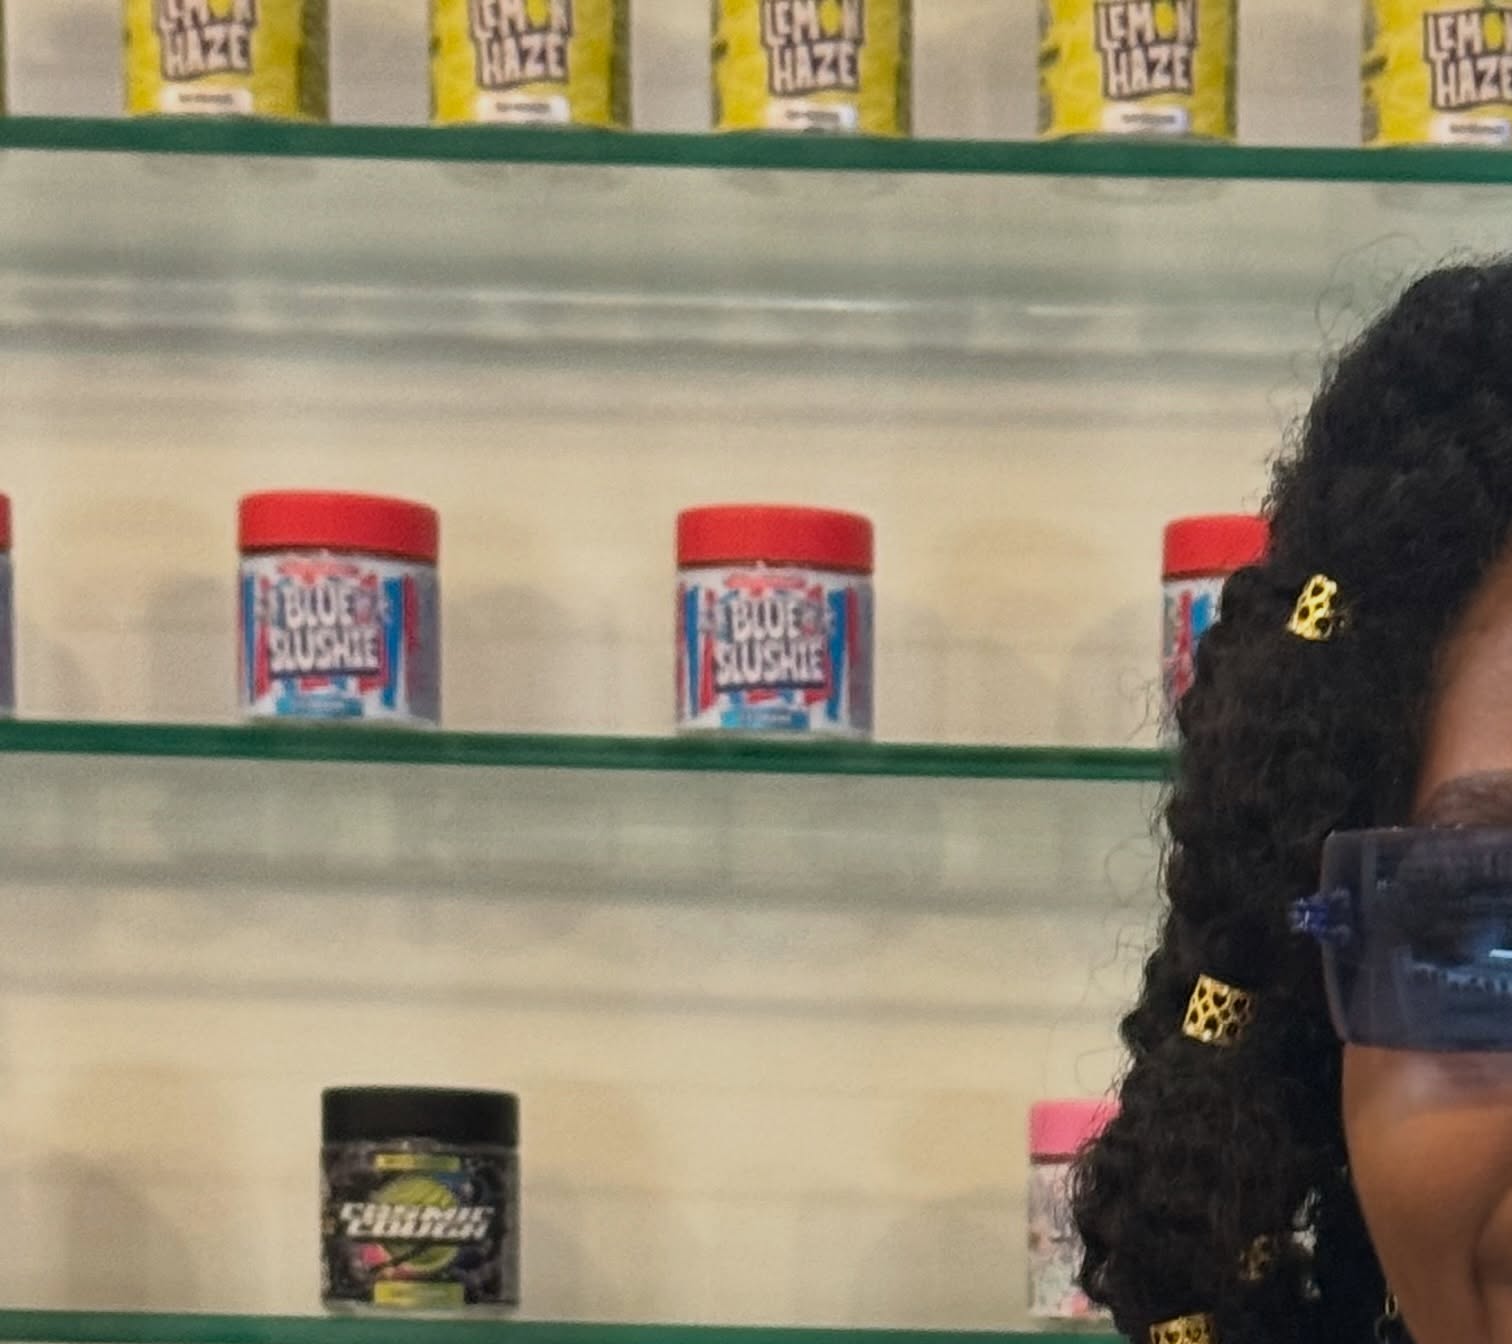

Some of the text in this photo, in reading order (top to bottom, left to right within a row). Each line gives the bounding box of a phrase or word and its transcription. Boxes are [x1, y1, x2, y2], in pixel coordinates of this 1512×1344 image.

[762, 0, 862, 46] LEMON
[1097, 1, 1195, 49] LEMON
[163, 24, 252, 79] HAZE
[478, 33, 567, 87] HAZE
[771, 42, 857, 94] HAZE
[1105, 45, 1191, 98] HAZE
[284, 585, 353, 629] BLUE
[731, 598, 800, 642] BLUE
[270, 627, 379, 671] SLUSHIE
[715, 638, 825, 686] SLUSHIE
